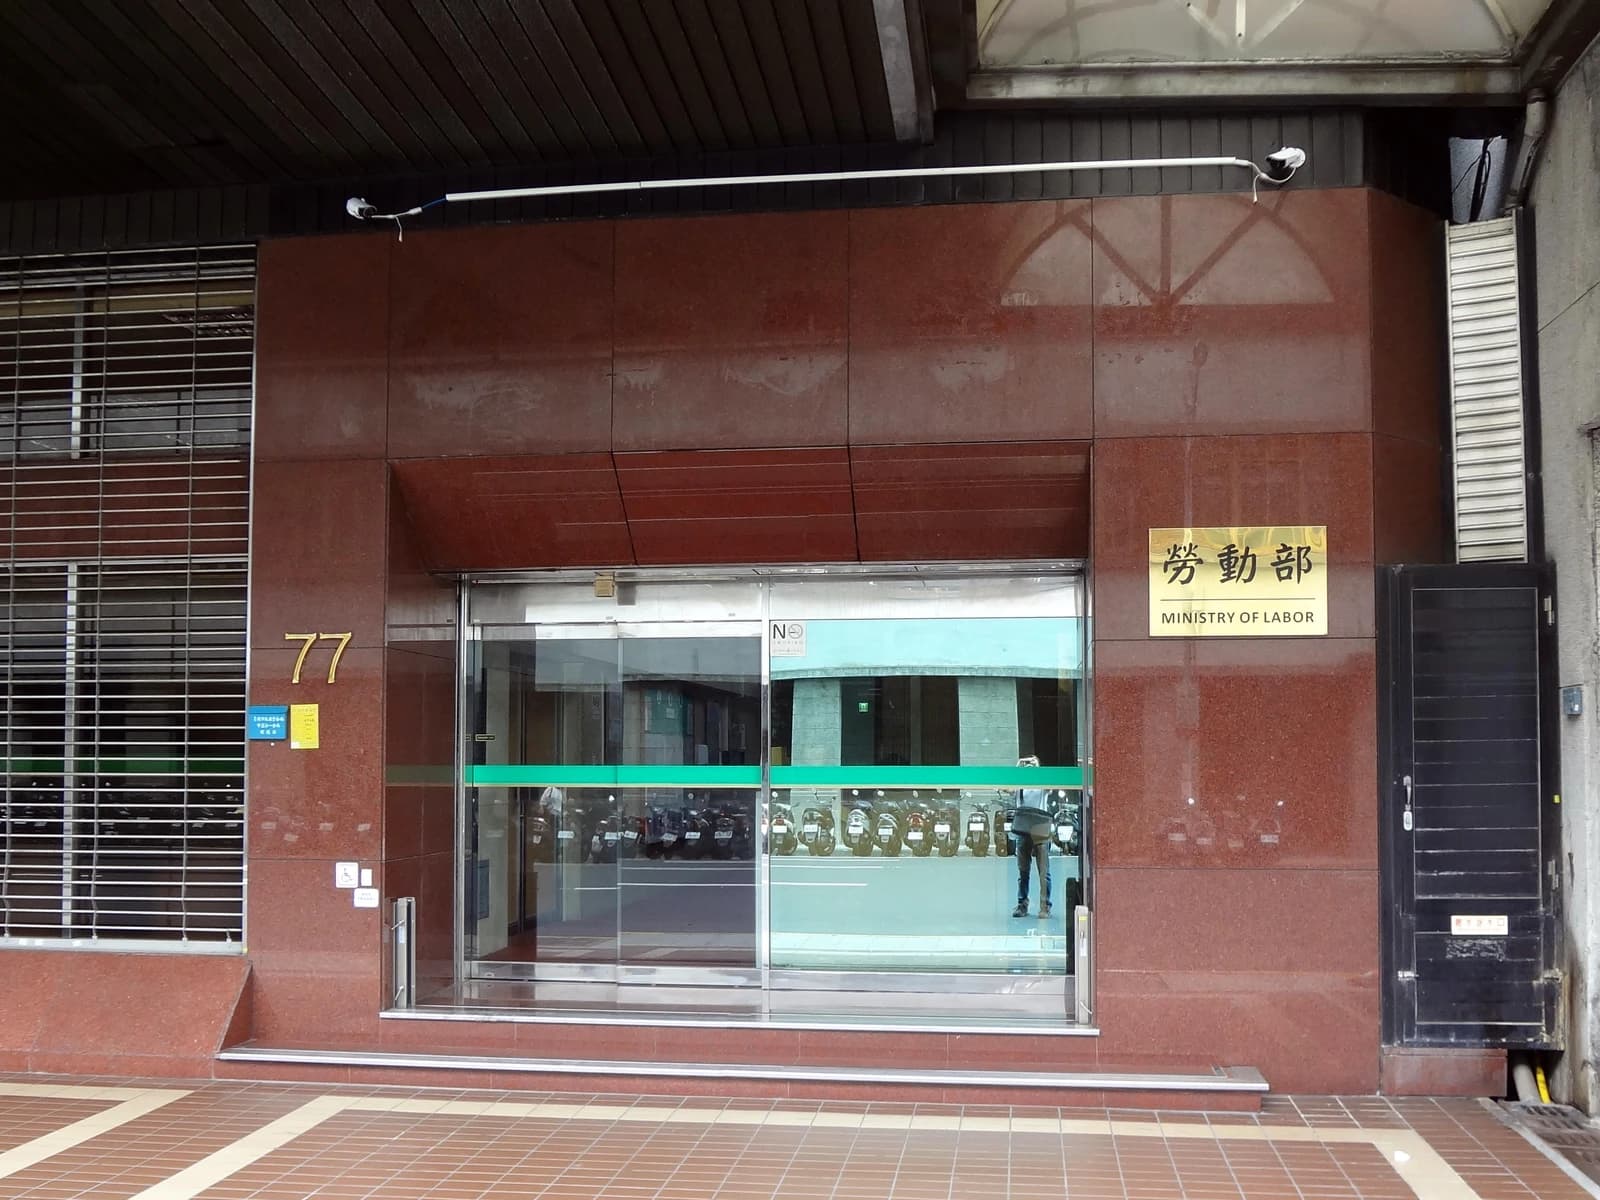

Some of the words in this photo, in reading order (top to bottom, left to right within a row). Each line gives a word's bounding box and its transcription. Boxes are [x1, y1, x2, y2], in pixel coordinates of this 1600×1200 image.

[1163, 543, 1313, 584] 勞動部
[1161, 611, 1235, 624] MINISTRY
[1239, 611, 1259, 624] OF
[1263, 611, 1314, 624] LABOR
[284, 632, 352, 684] 77
